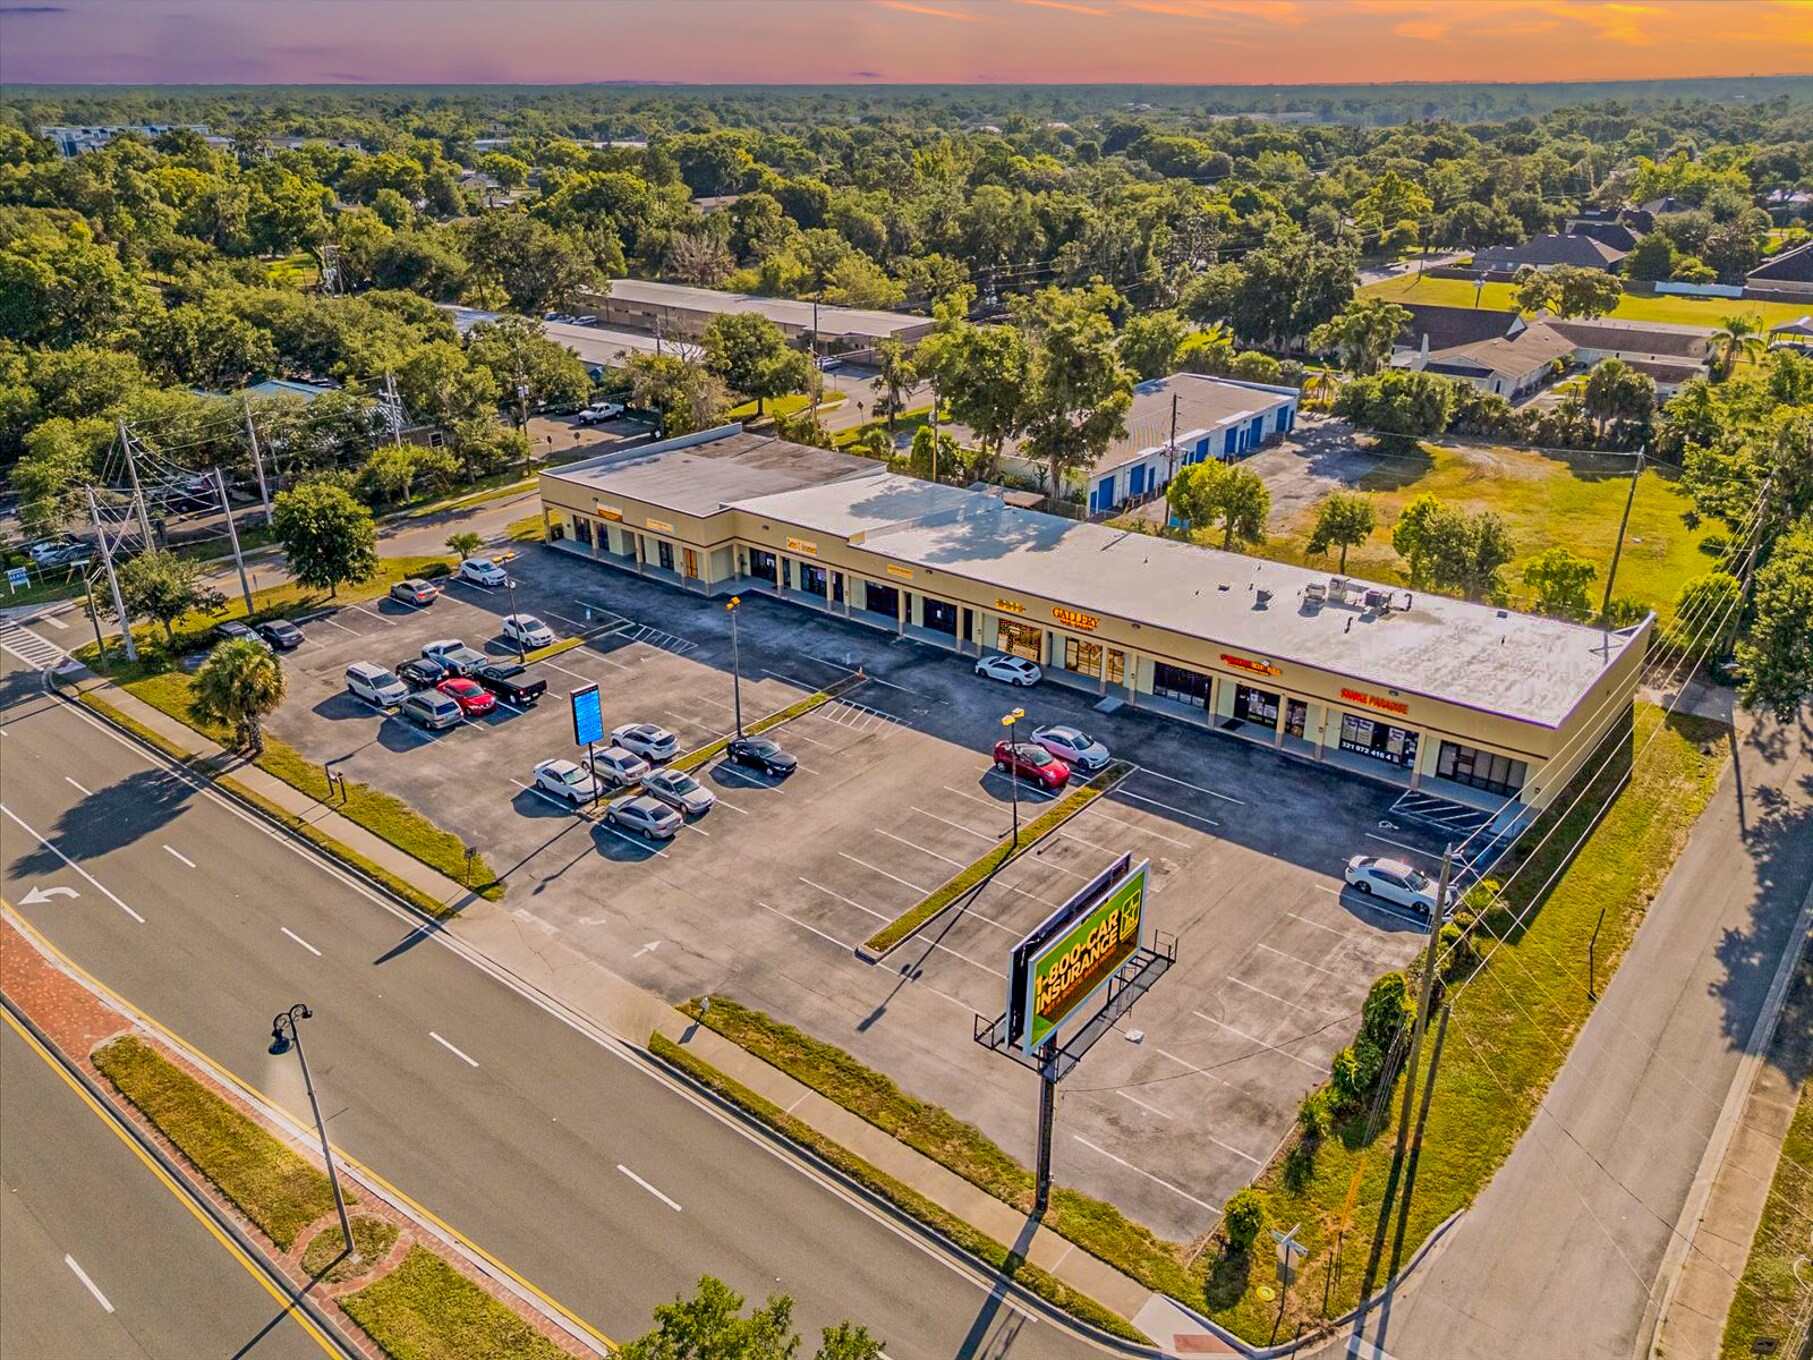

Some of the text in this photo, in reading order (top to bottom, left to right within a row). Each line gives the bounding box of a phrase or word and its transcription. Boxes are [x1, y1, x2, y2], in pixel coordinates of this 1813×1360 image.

[1051, 606, 1100, 628] GALLERY
[1342, 742, 1354, 751] 321
[1035, 925, 1118, 1015] INSURANCE
[1036, 908, 1119, 996] 1-800-CAR
